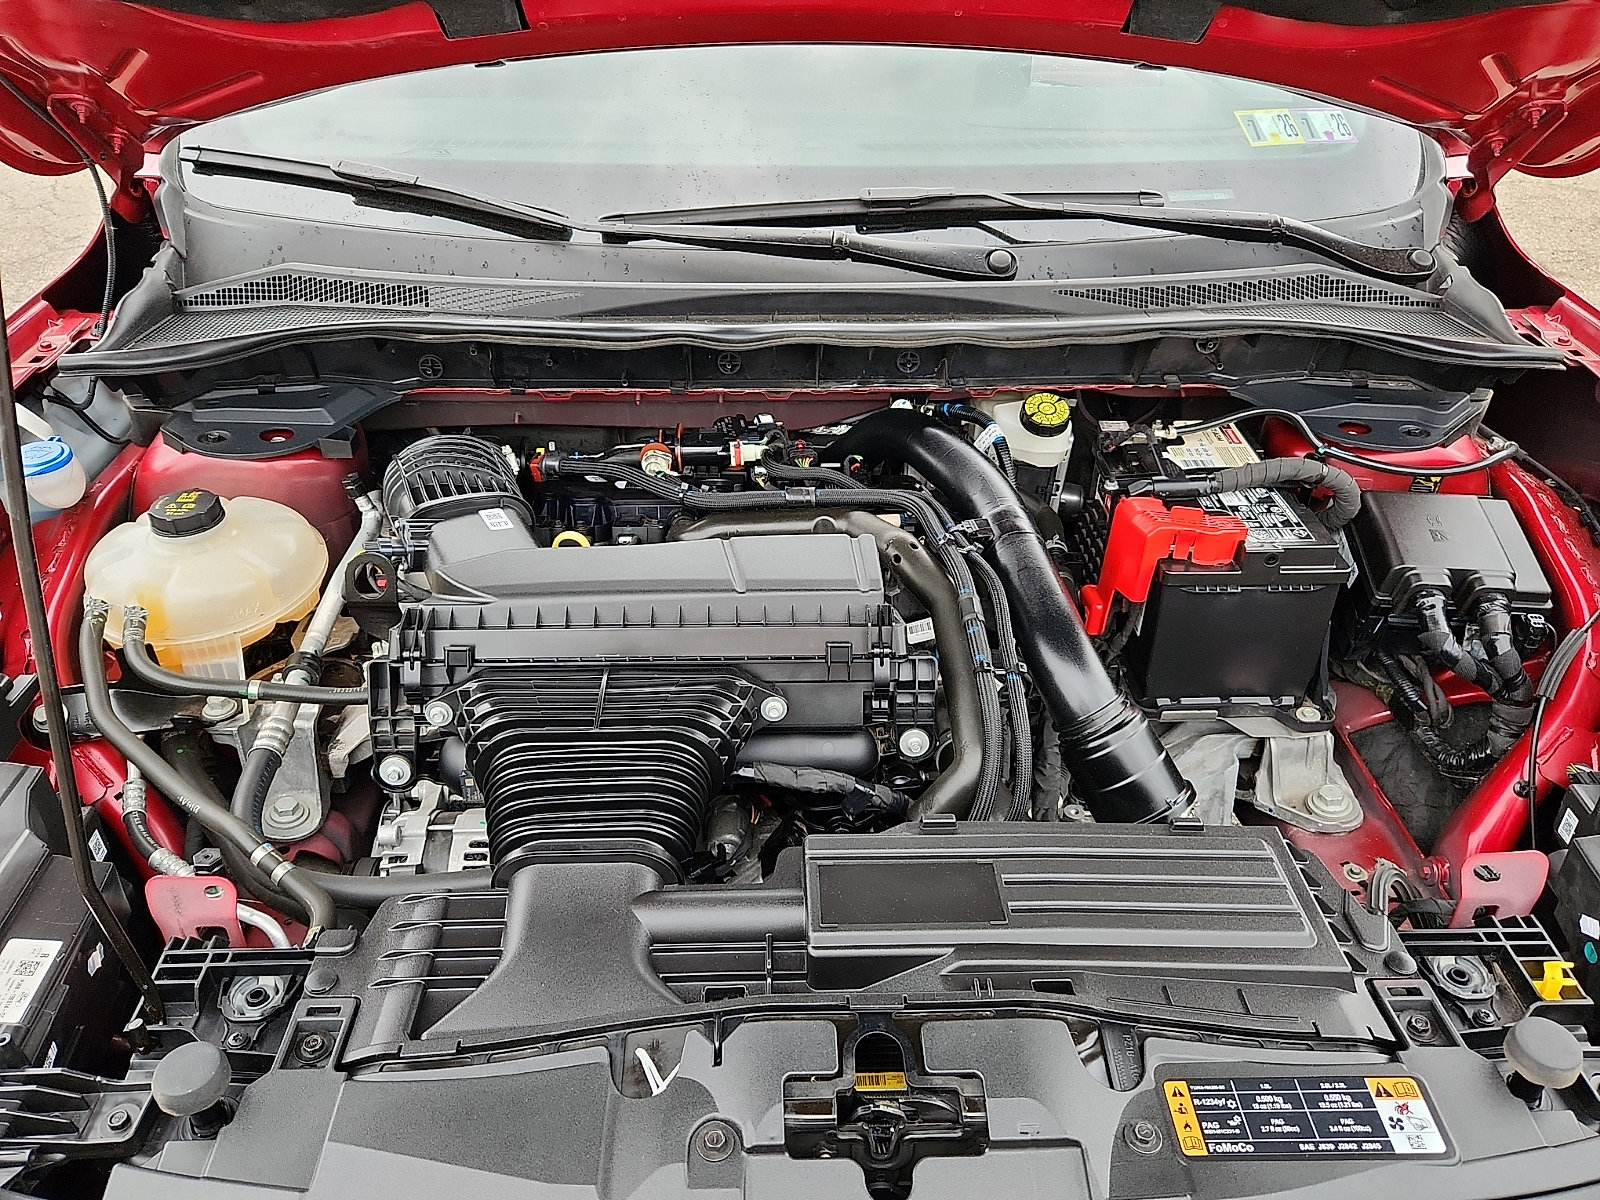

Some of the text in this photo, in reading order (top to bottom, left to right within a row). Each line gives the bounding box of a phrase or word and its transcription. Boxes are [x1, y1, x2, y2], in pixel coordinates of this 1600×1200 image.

[1277, 113, 1299, 137] 26
[1330, 113, 1352, 137] 26
[1193, 1097, 1226, 1107] R-1234yf
[1201, 1121, 1221, 1129] PAG
[1208, 1143, 1255, 1153] FoMoCo
